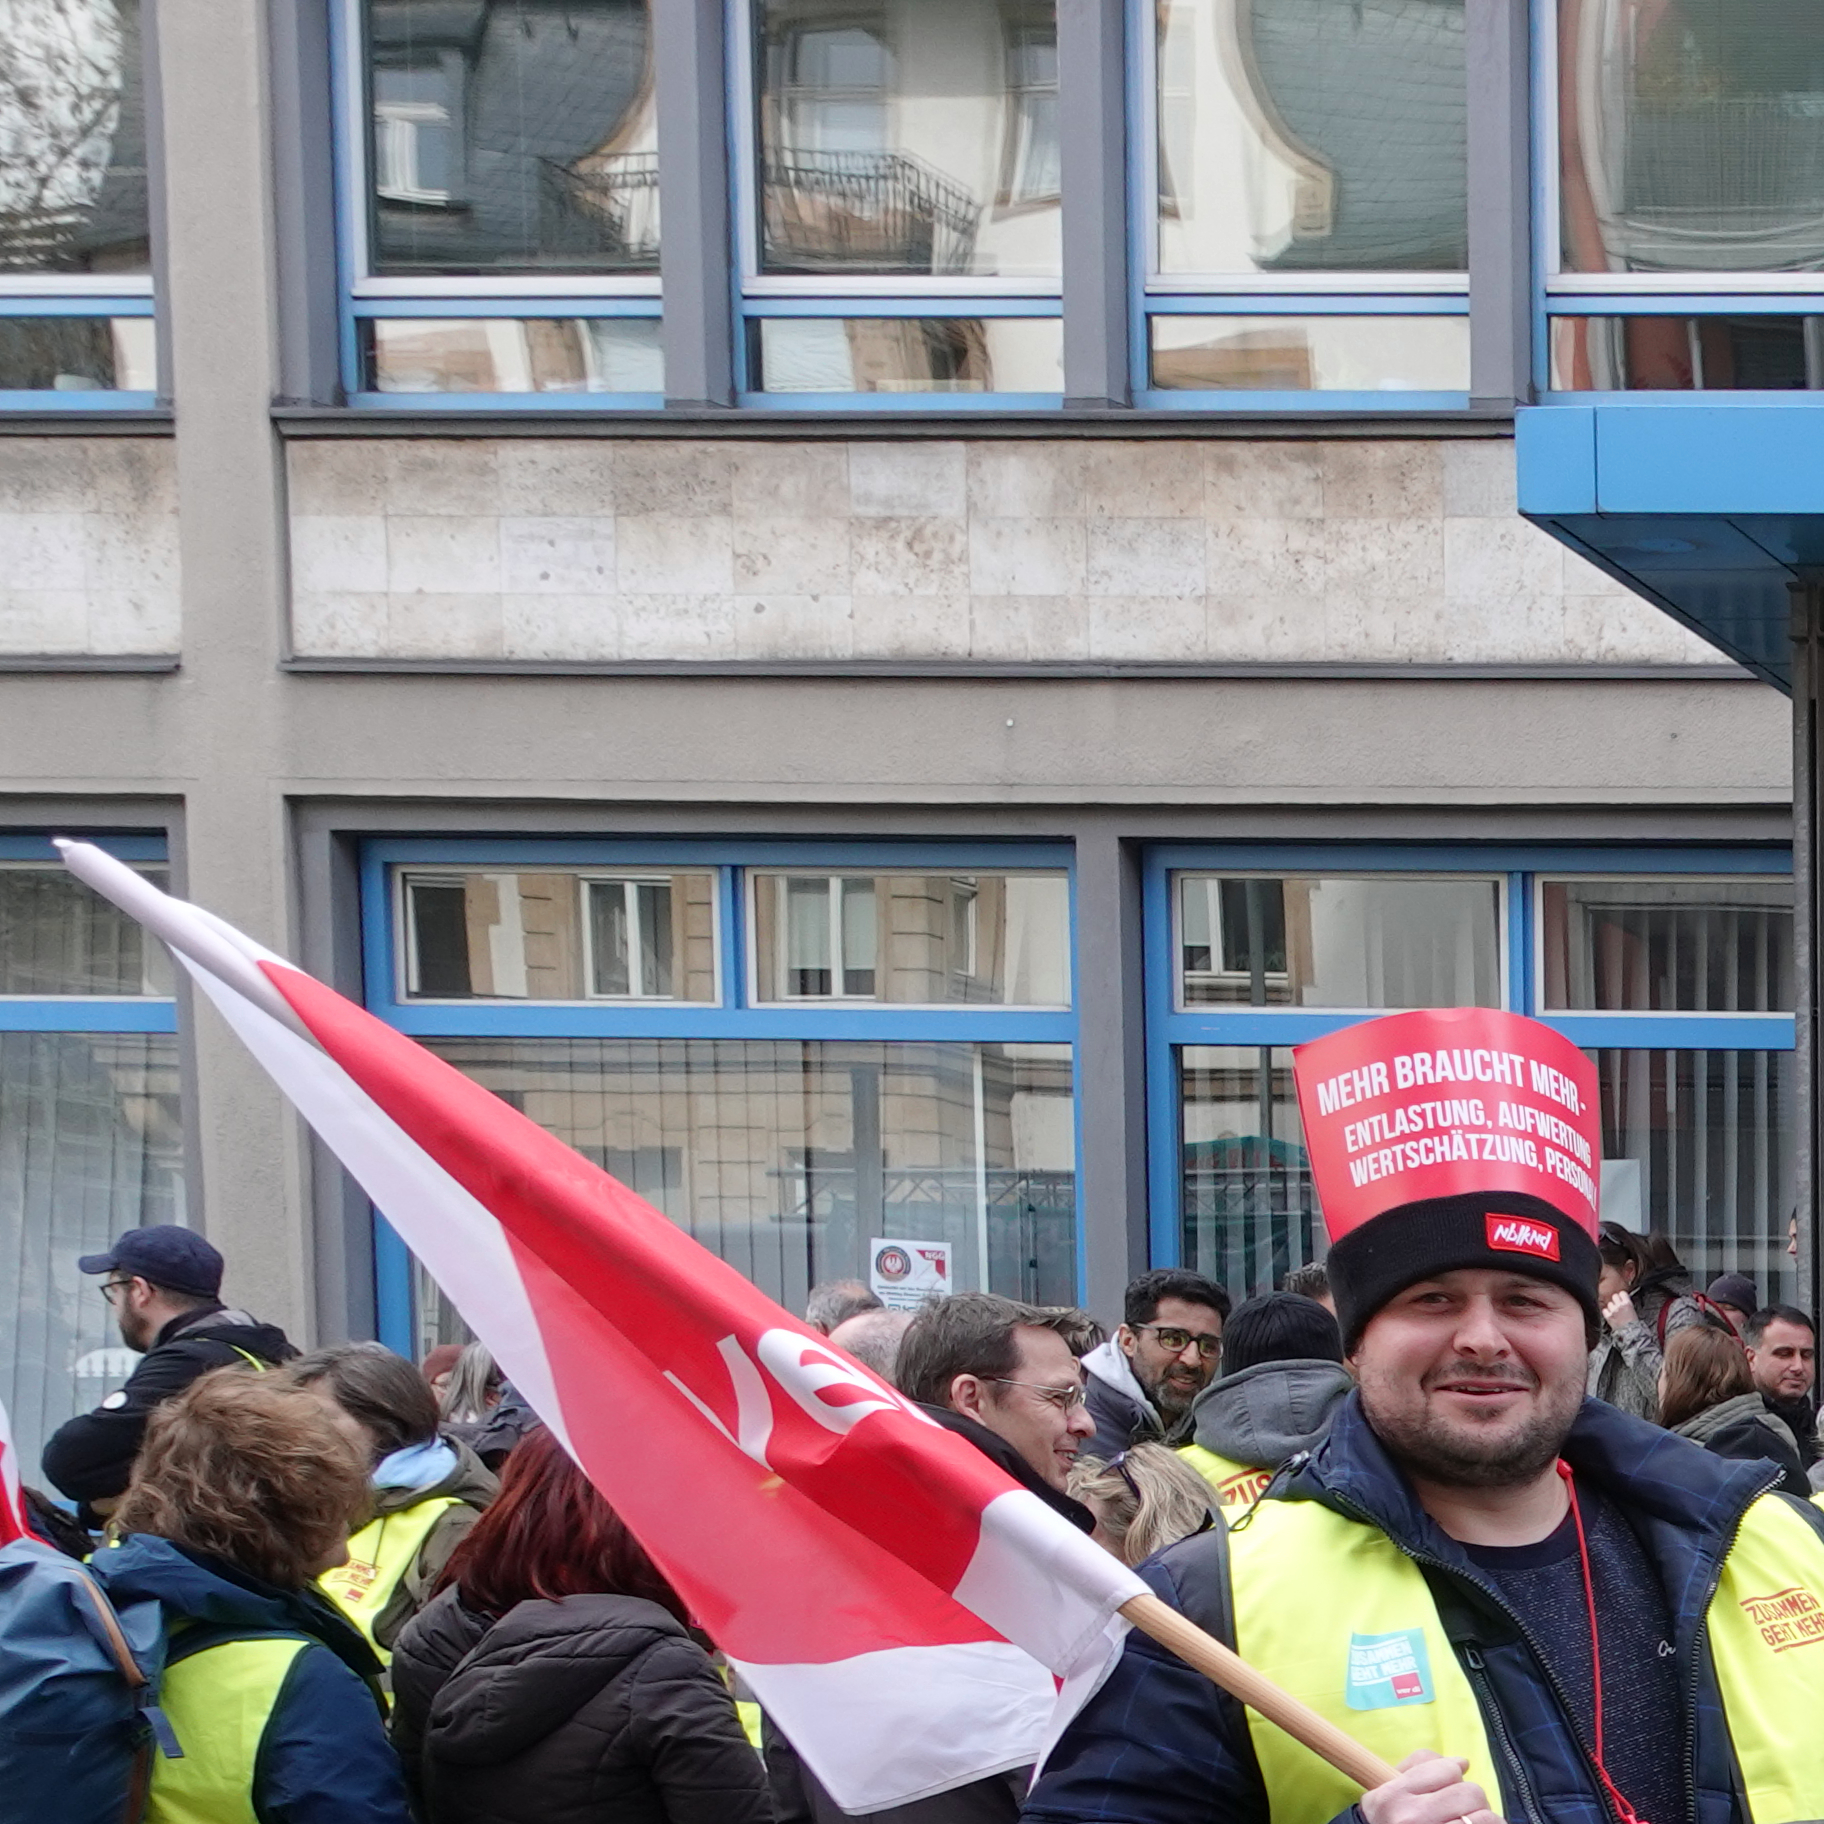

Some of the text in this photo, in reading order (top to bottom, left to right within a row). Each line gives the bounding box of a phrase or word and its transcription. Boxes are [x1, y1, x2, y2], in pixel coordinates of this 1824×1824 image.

[1316, 1061, 1390, 1117] MEHR
[1394, 1048, 1526, 1090] BRAUCHT
[1344, 1099, 1493, 1154] ENTLASTUNG,
[1349, 1130, 1544, 1188] WERTSCHÄTZUNG,
[1745, 1592, 1821, 1626] ZUSAMMEN
[1760, 1622, 1798, 1647] GEHT
